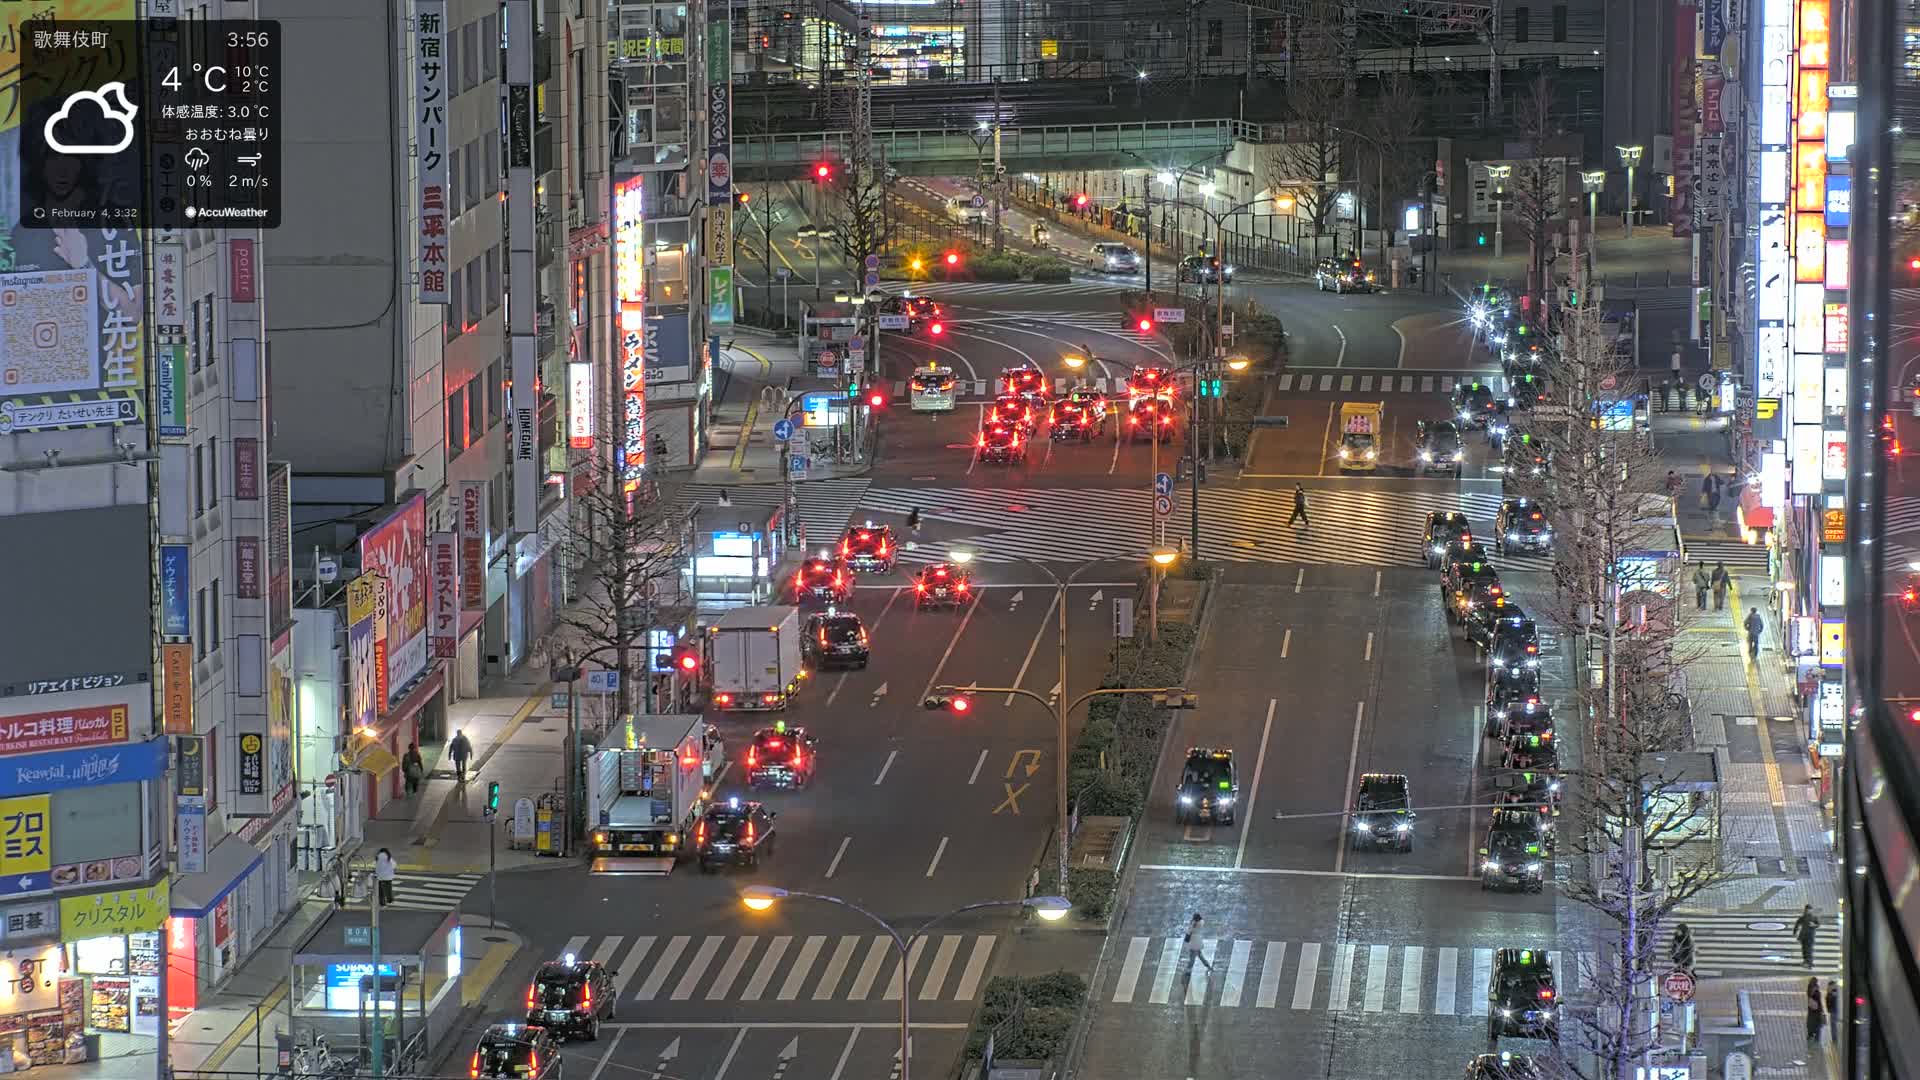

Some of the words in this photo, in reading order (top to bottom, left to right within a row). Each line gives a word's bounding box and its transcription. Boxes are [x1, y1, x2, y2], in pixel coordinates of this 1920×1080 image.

[420, 13, 442, 170] 新宿サンパーク
[1708, 89, 1719, 121] アコム
[711, 162, 729, 178] 薬
[423, 186, 444, 292] 三平本館
[161, 325, 180, 335] 3F
[161, 354, 173, 416] FamilyMart
[18, 409, 53, 423] テンクリ
[58, 404, 116, 420] たいせい先生
[519, 409, 532, 460] HOMEGAME
[464, 488, 475, 532] GAME
[437, 543, 454, 630] 三平ストア
[28, 678, 79, 694] リアエイド
[83, 675, 124, 688] ビジョン
[113, 711, 123, 736] 5F
[4, 812, 44, 836] プロ
[4, 837, 44, 859] ミス
[8, 912, 43, 932] 囲碁
[73, 903, 146, 928] クリスタル
